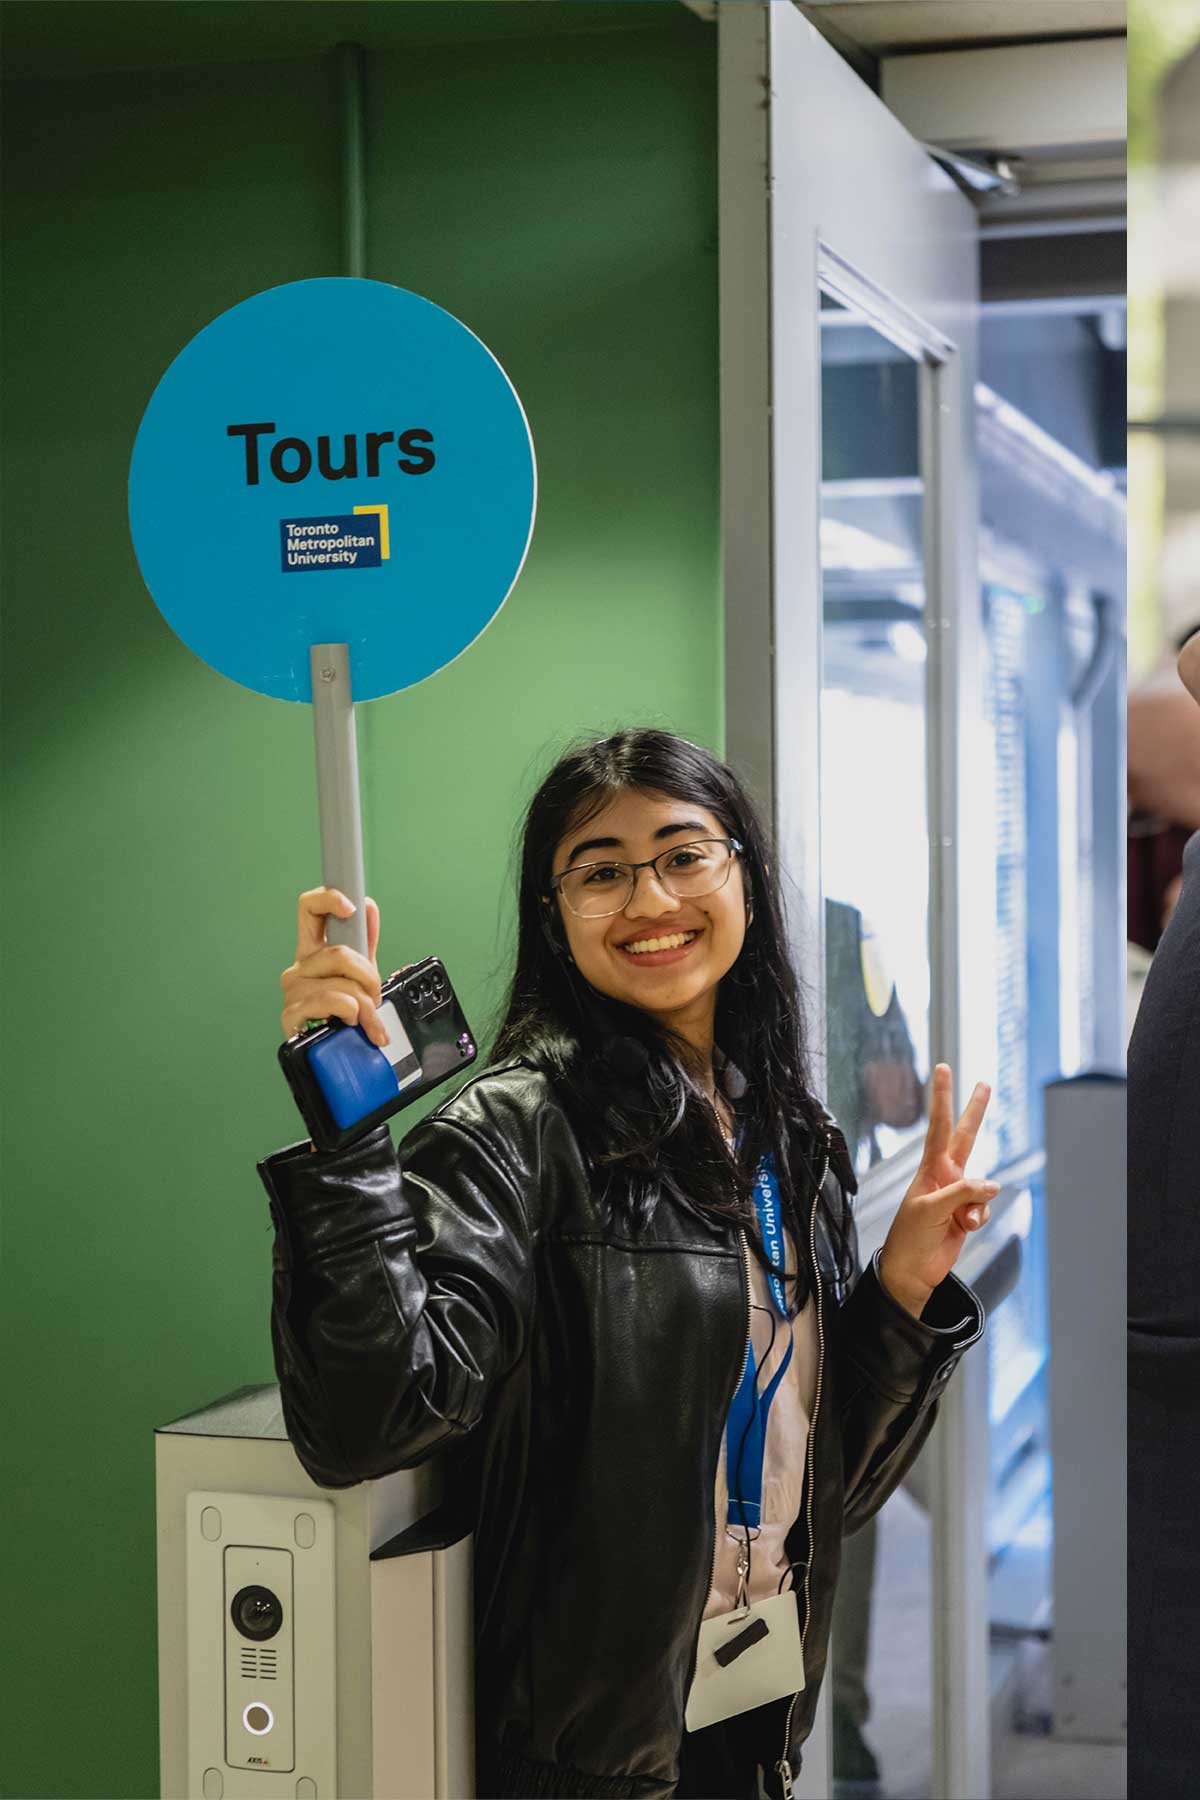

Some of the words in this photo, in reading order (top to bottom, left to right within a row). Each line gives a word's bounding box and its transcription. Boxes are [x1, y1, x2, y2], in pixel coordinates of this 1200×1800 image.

[227, 422, 436, 486] Tours
[286, 524, 339, 537] Toronto
[287, 535, 375, 552] Metropolitan
[287, 550, 358, 566] University
[757, 1156, 777, 1235] Univers
